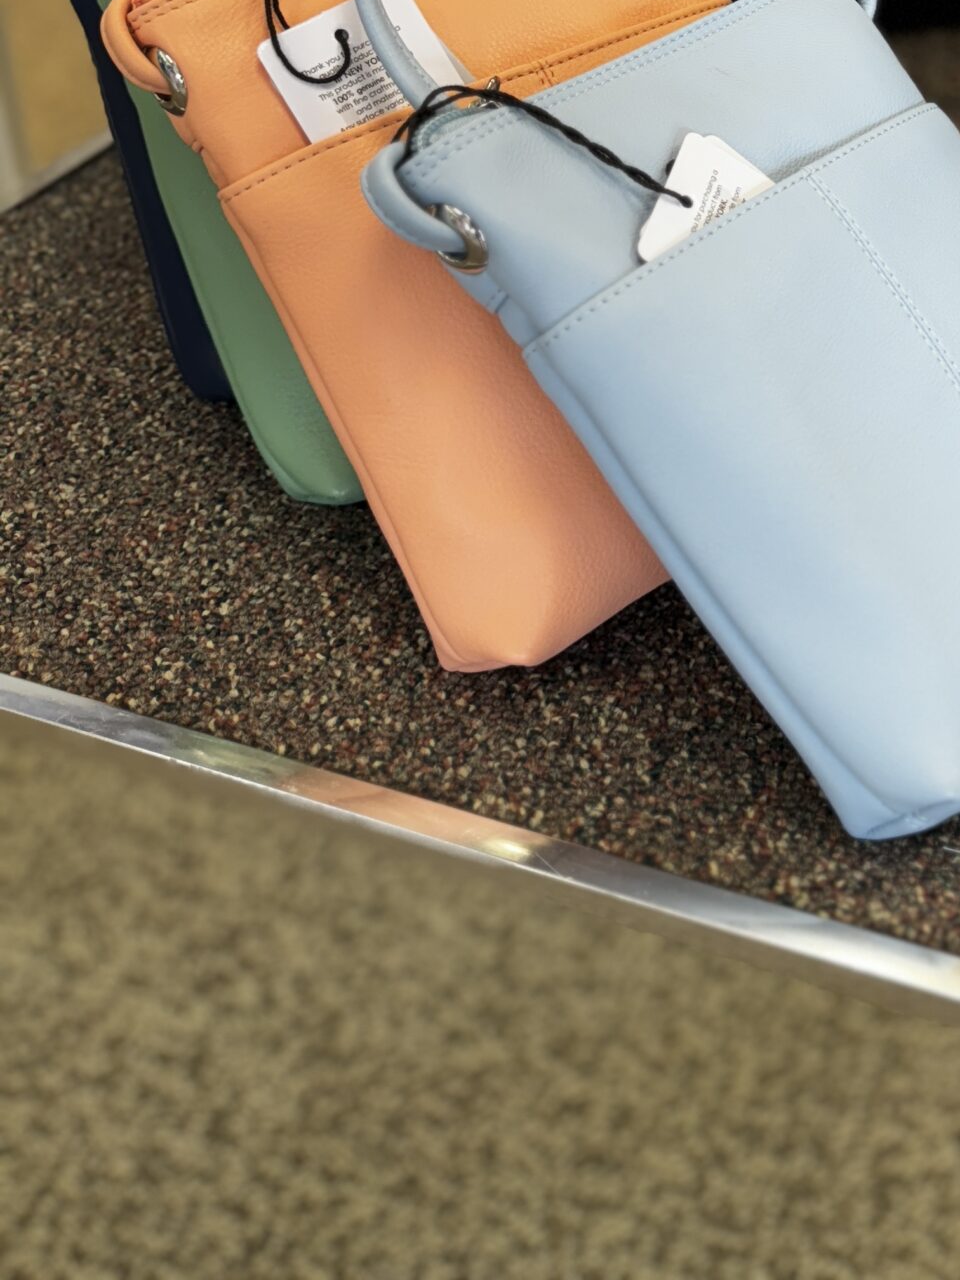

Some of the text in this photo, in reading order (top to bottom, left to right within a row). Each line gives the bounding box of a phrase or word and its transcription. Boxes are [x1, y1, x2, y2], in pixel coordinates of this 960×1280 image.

[324, 55, 341, 68] you
[344, 64, 363, 79] NEW
[318, 91, 335, 102] This
[334, 74, 366, 96] product
[332, 76, 386, 105] 100% genuine
[337, 102, 354, 114] with
[353, 94, 369, 105] fine
[356, 102, 373, 115] and
[356, 108, 385, 125] surface
[699, 175, 718, 213] purchasing
